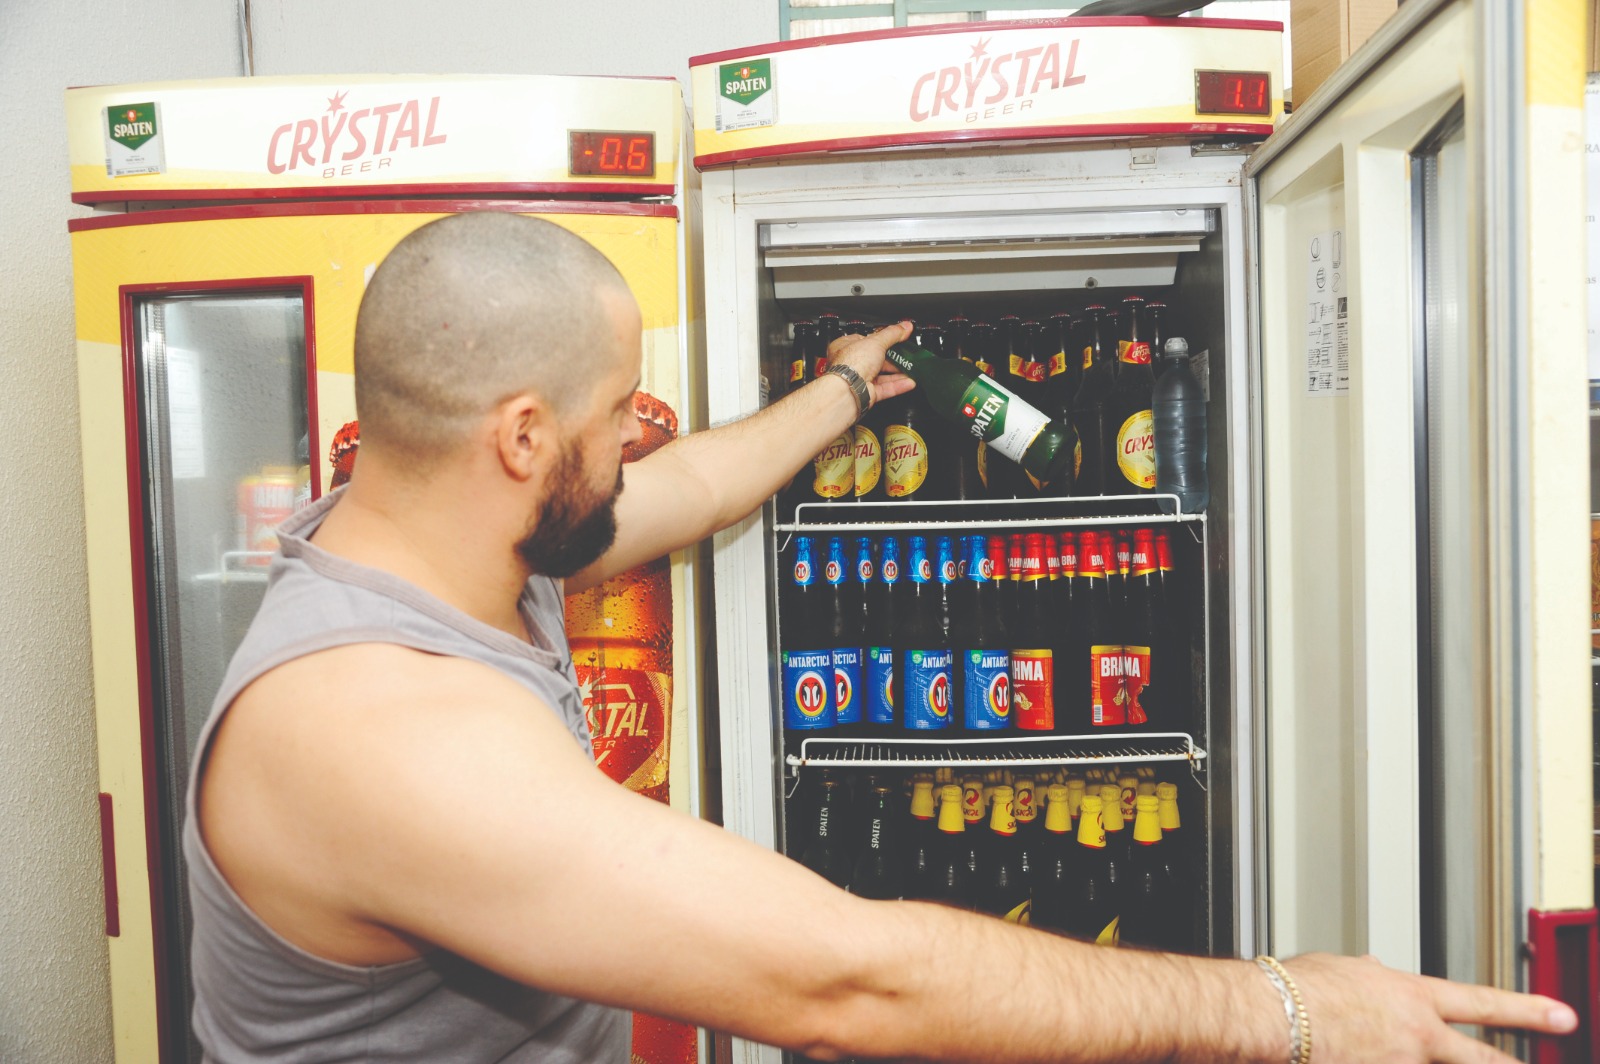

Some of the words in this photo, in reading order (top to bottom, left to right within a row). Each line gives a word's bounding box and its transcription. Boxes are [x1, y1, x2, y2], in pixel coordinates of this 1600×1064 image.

[725, 77, 767, 95] SPATEN
[909, 39, 1087, 123] CRYSTAL
[965, 99, 1033, 123] BEER
[113, 121, 153, 138] SPATEN
[267, 96, 447, 175] CRYSTAL
[322, 157, 392, 179] BEER
[887, 349, 914, 371] SPATEN
[788, 655, 830, 668] ANTARCTICA
[1012, 660, 1044, 681] HMA
[819, 807, 829, 837] SPATEN
[1015, 808, 1034, 817] SKOL
[871, 818, 881, 849] SPATEN
